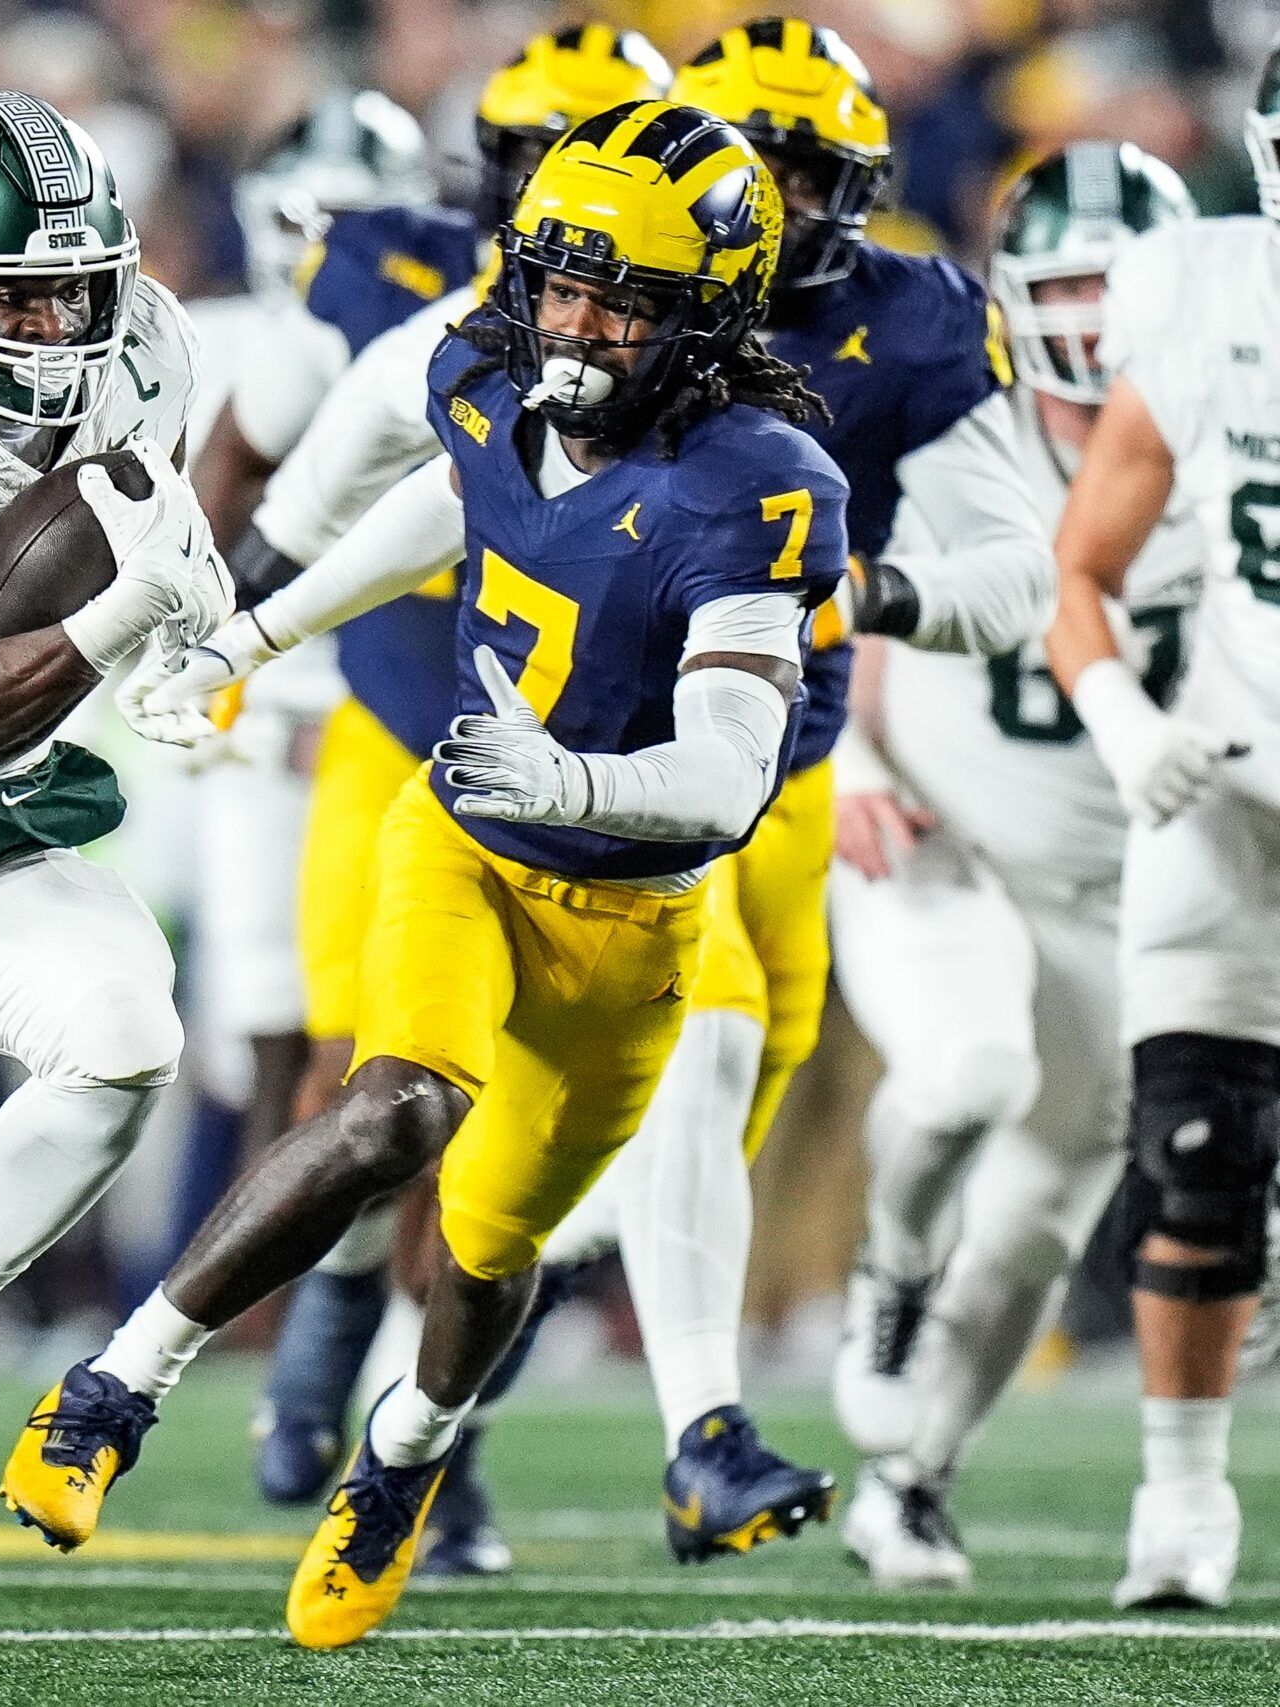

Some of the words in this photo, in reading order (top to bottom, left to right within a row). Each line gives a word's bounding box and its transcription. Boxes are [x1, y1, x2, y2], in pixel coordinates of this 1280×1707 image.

[48, 231, 88, 249] STATE
[562, 226, 586, 247] M
[759, 488, 814, 580] 7
[475, 548, 581, 726] 7
[65, 1475, 86, 1494] M
[323, 1582, 348, 1601] M
